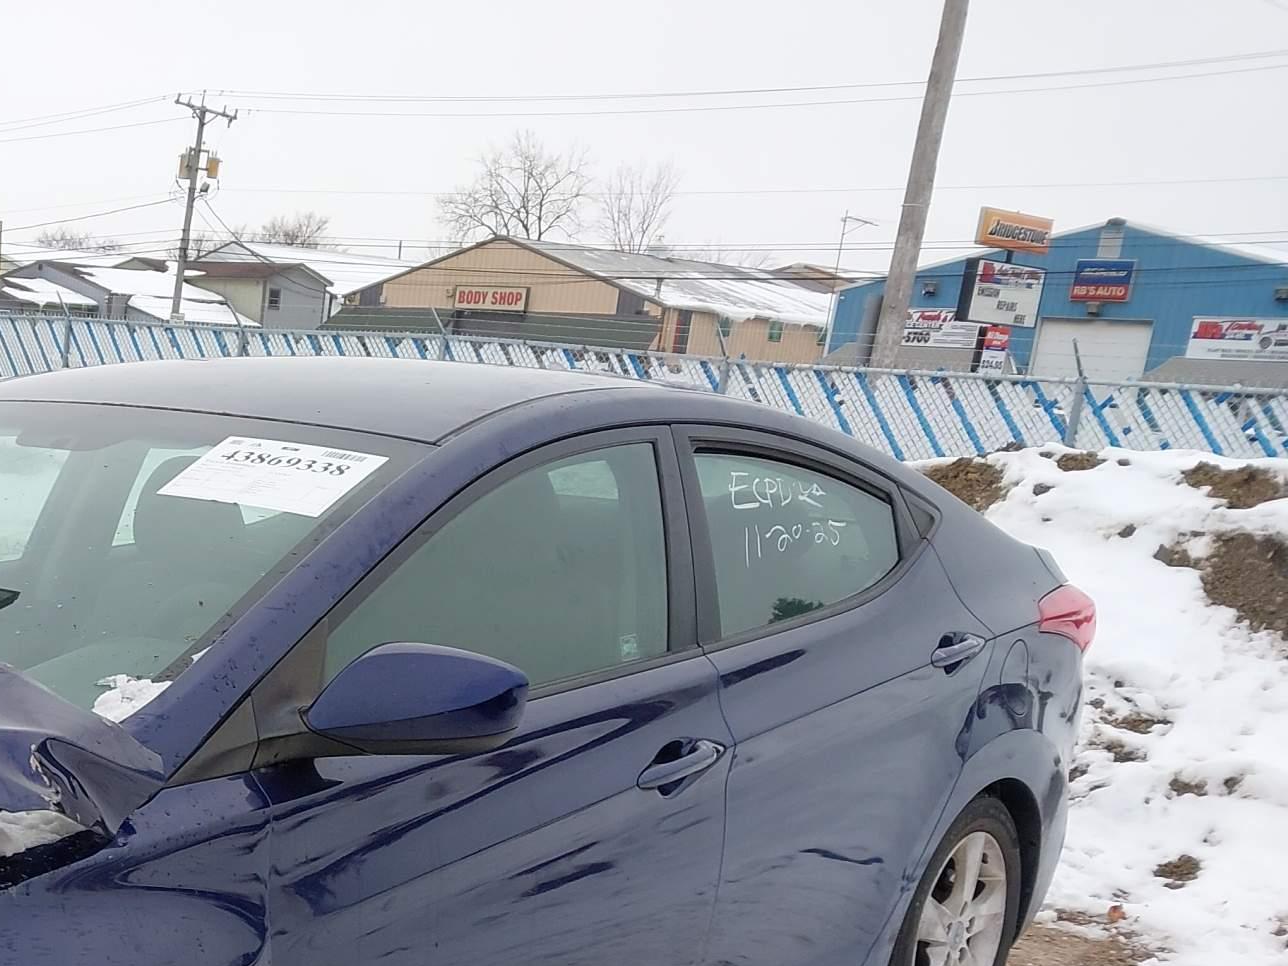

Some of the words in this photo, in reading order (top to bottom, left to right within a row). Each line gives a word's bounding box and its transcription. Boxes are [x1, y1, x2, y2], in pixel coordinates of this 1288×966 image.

[458, 290, 488, 304] BODY
[491, 291, 523, 306] SHOP
[1096, 287, 1125, 296] AUTO
[221, 449, 352, 477] 43869338
